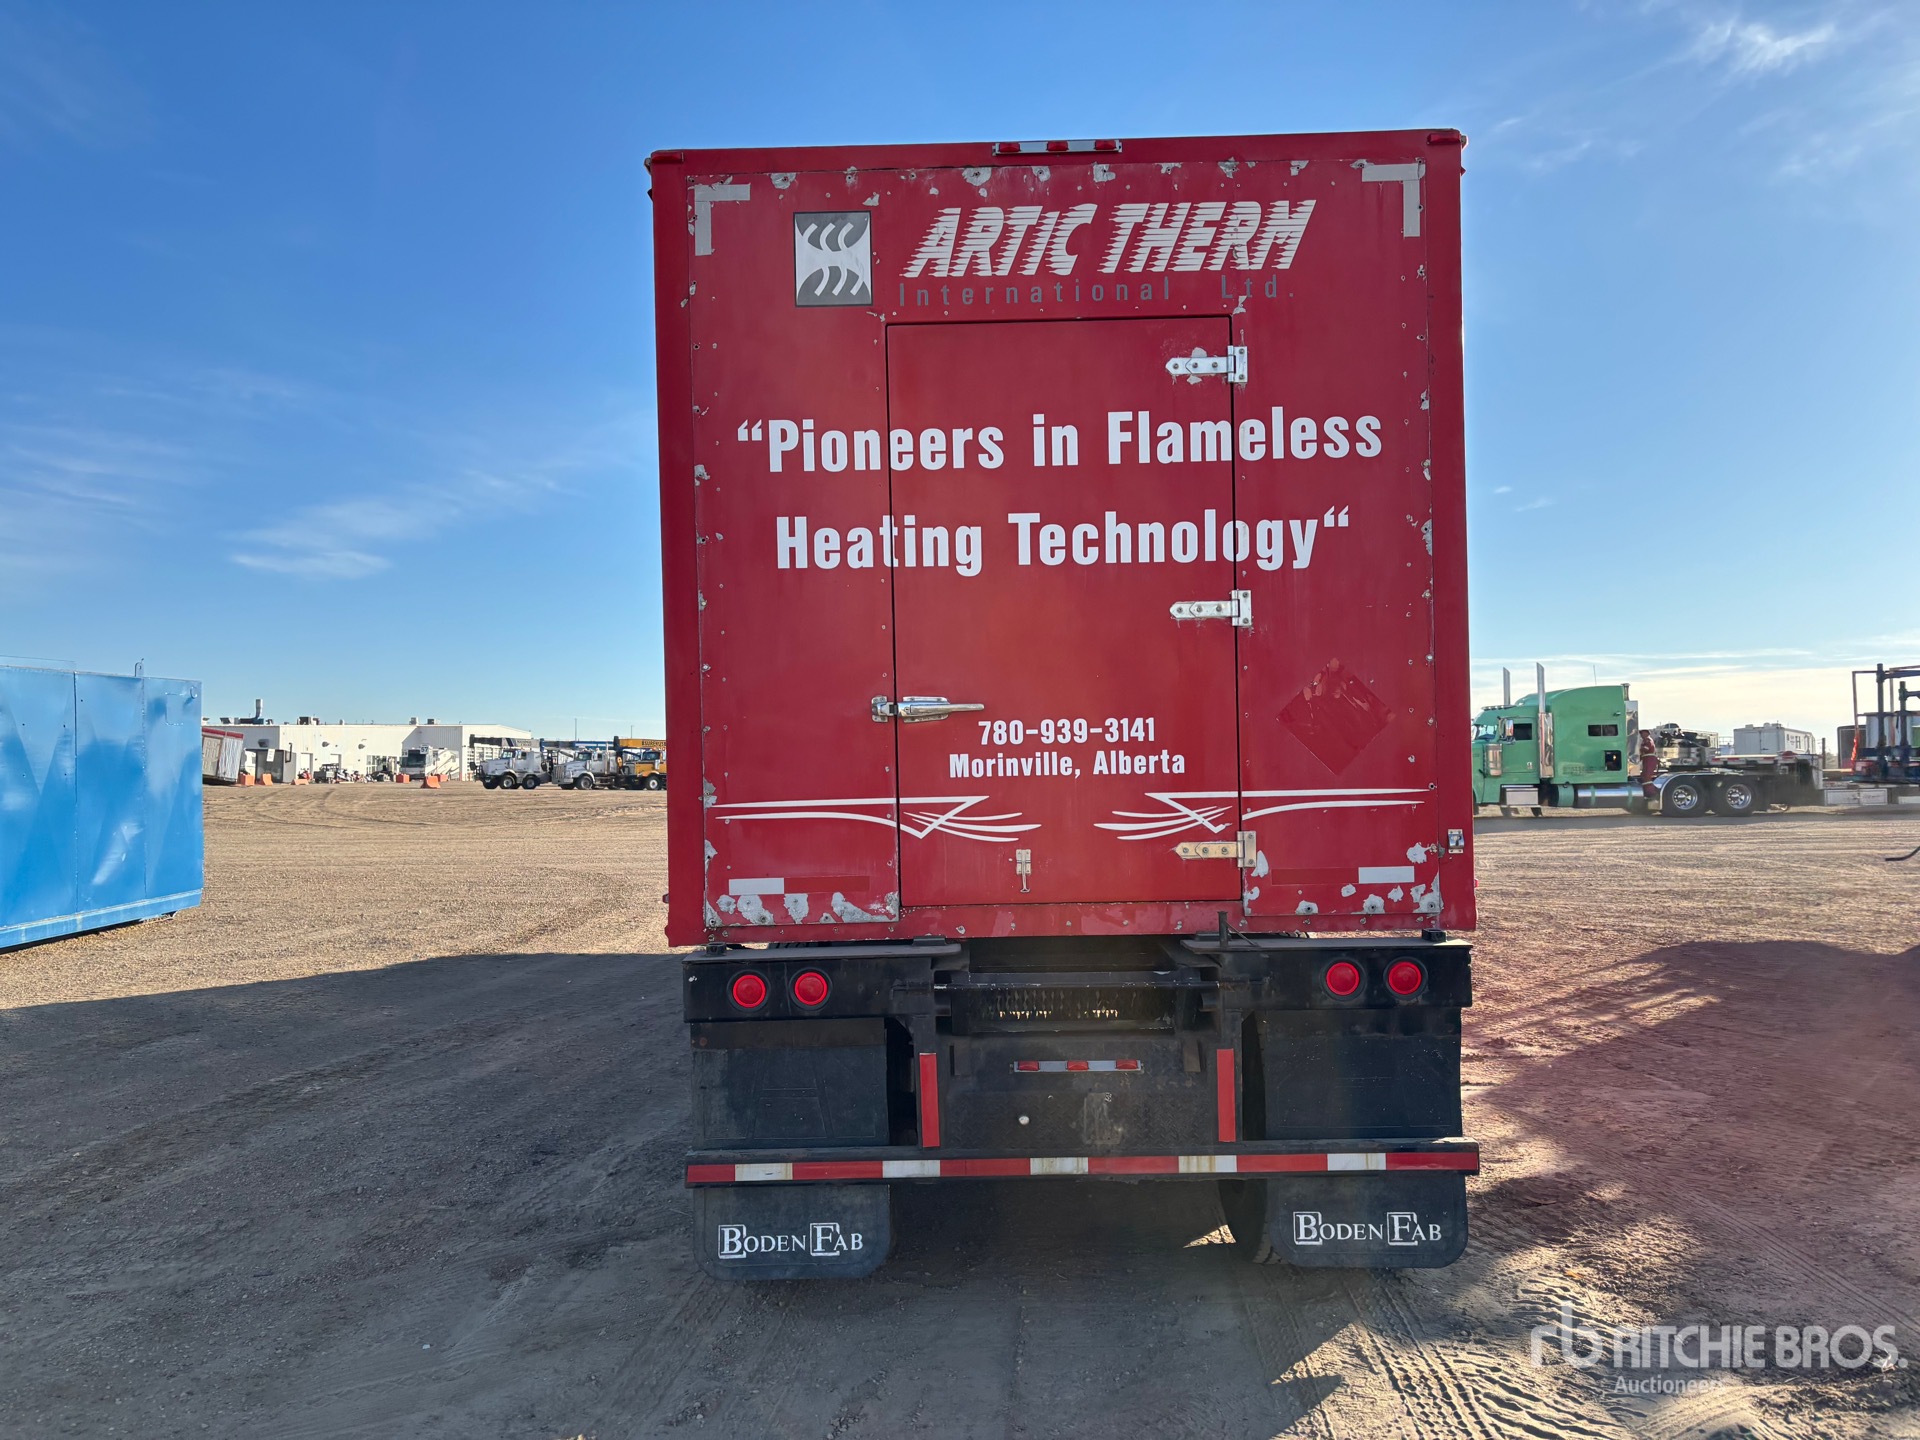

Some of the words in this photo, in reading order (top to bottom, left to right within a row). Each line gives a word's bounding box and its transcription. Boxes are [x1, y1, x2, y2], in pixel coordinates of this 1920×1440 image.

[899, 203, 1098, 278] ARTIC
[1097, 199, 1317, 273] THERM
[899, 275, 1170, 307] International
[1220, 274, 1295, 299] Ltd.
[737, 418, 1005, 473] “Pioneers
[1032, 413, 1080, 467] in
[1107, 405, 1383, 465] Flameless
[776, 514, 983, 578] Heating
[978, 717, 1155, 746] 780-939-3141
[950, 751, 1081, 779] Morinville,
[1093, 749, 1186, 775] Alberta
